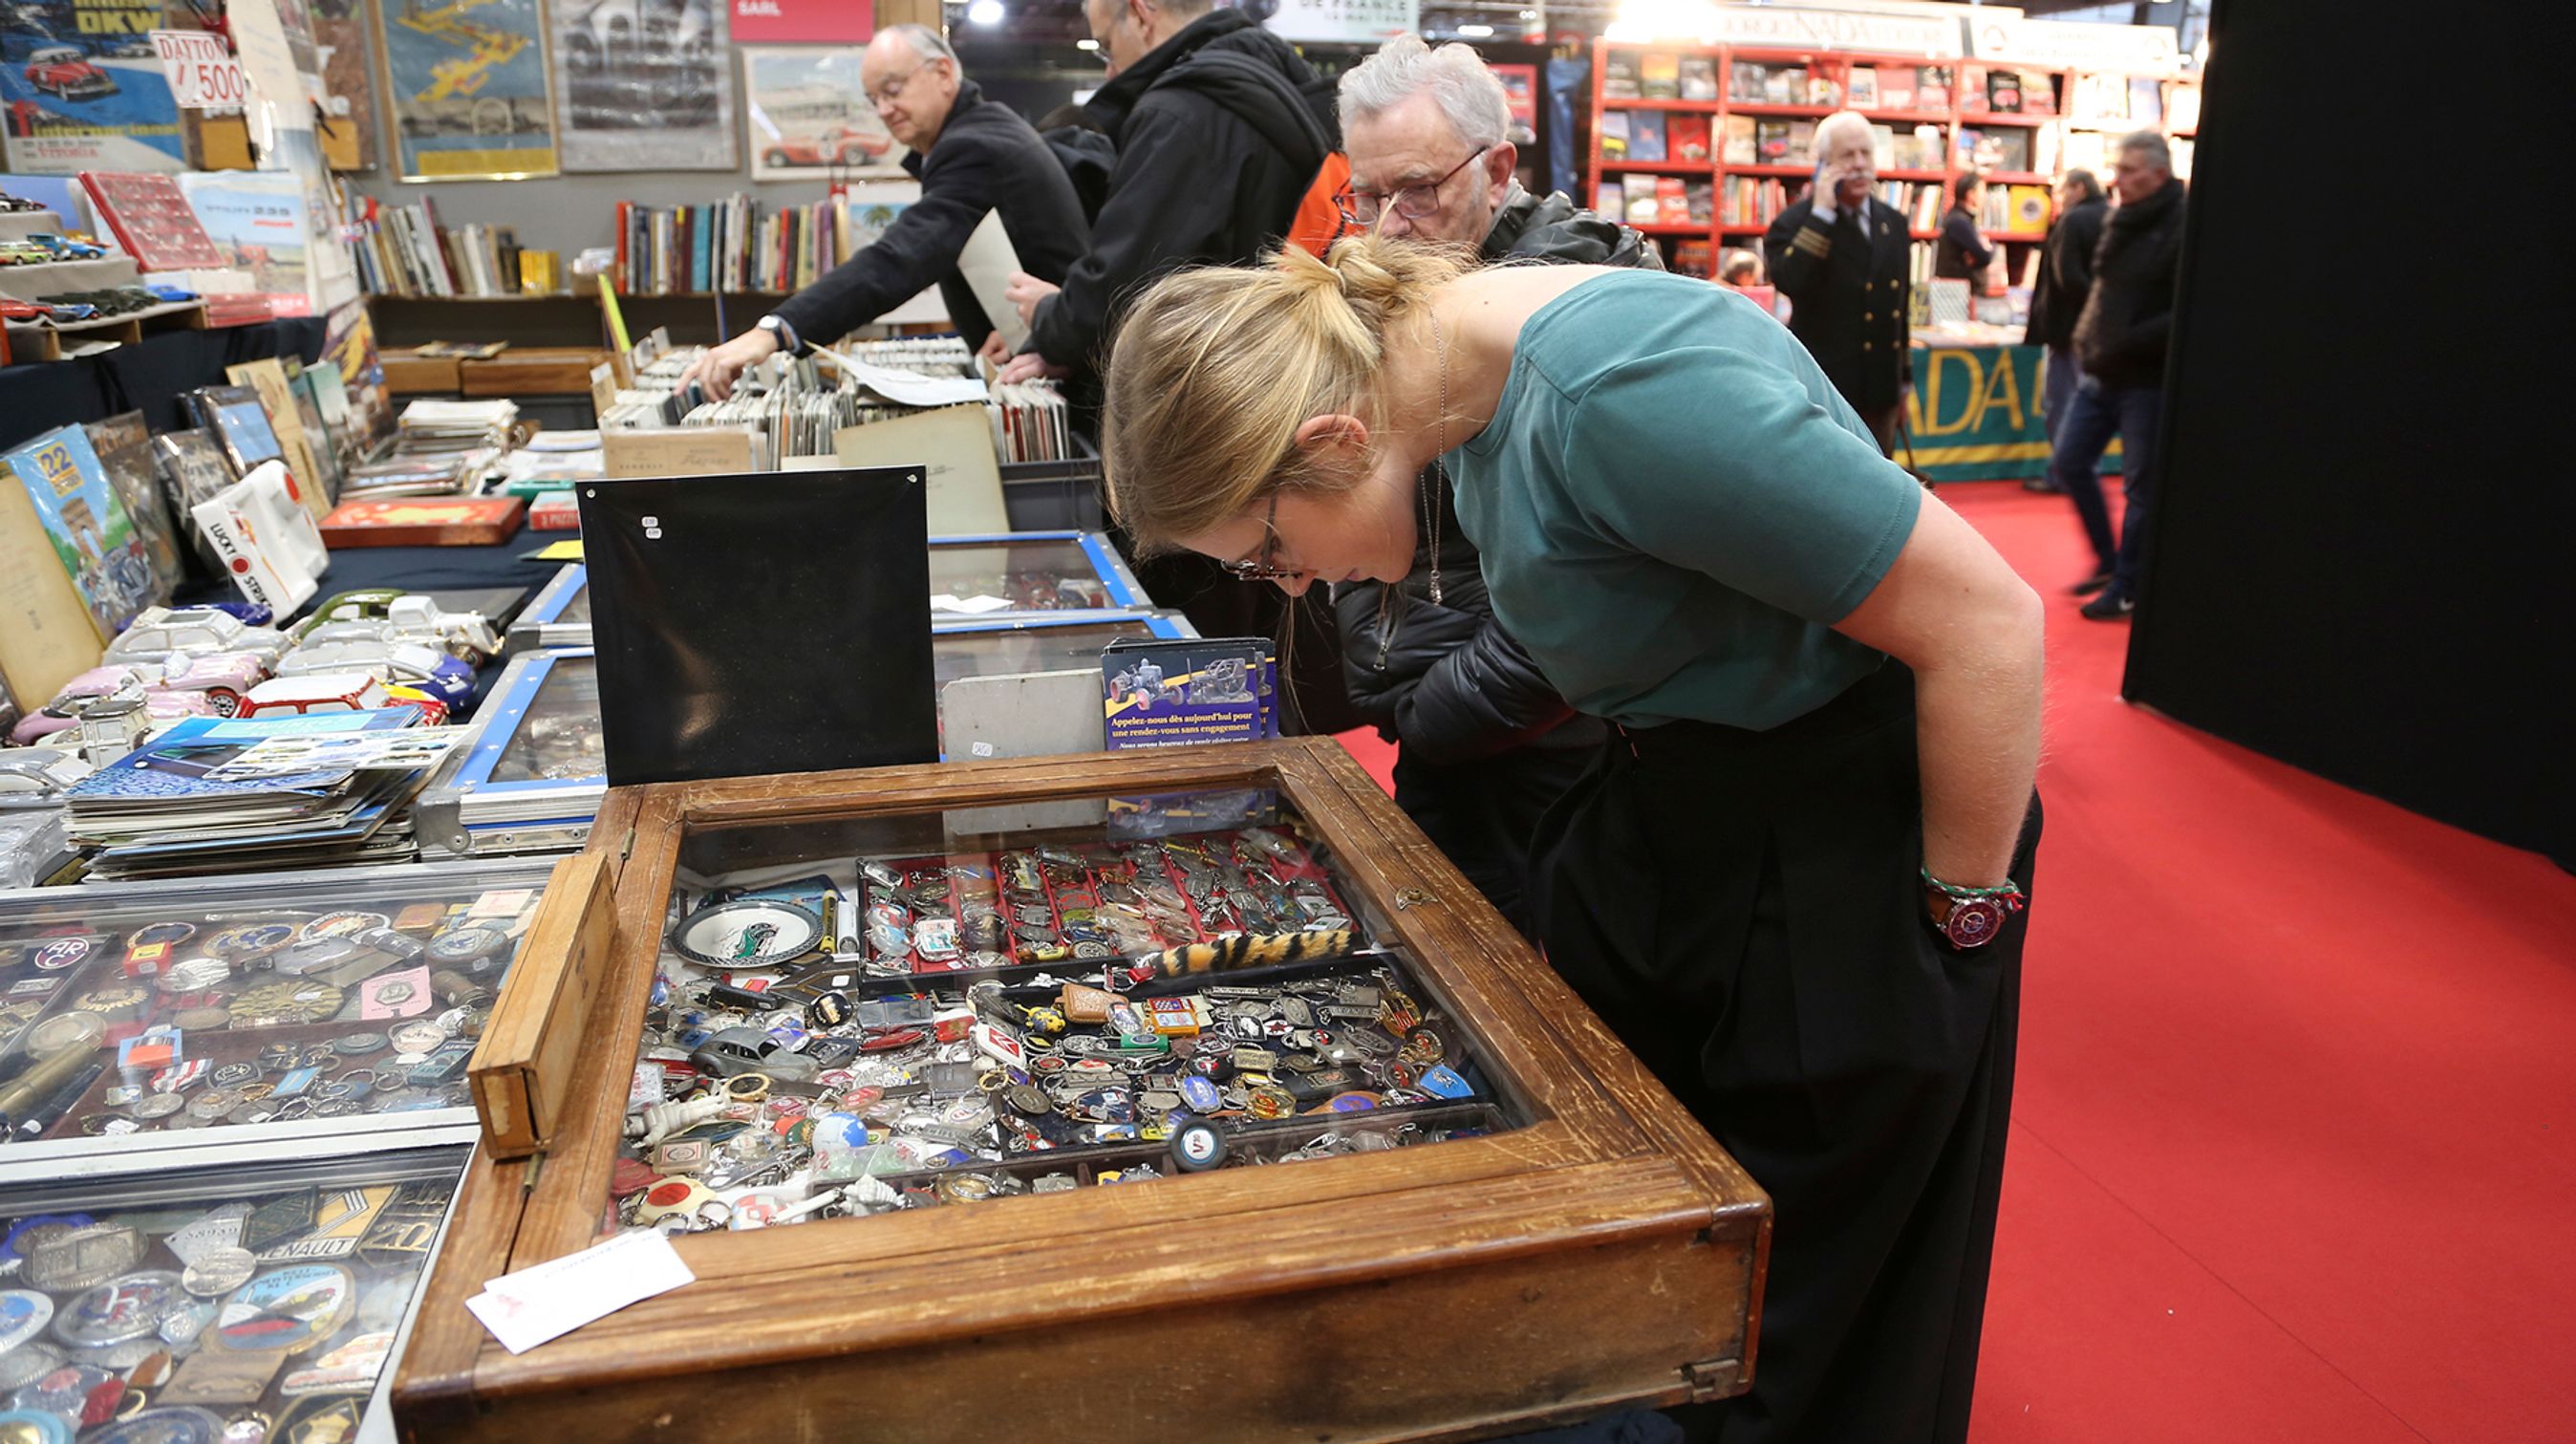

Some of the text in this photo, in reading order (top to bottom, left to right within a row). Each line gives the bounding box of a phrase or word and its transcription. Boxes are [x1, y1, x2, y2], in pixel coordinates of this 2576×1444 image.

[737, 0, 782, 16] SARL
[75, 11, 163, 34] DKW
[198, 64, 244, 99] 500
[41, 446, 73, 479] 22
[209, 523, 238, 555] LUCKY
[1111, 717, 1168, 727] Appelez-nous
[1169, 715, 1183, 723] dès
[1184, 712, 1232, 723] aujourd'hui
[1233, 713, 1253, 722] pour
[1129, 728, 1180, 737] rendez-vous
[1200, 723, 1250, 734] engagement
[258, 1239, 352, 1259] ENAULT
